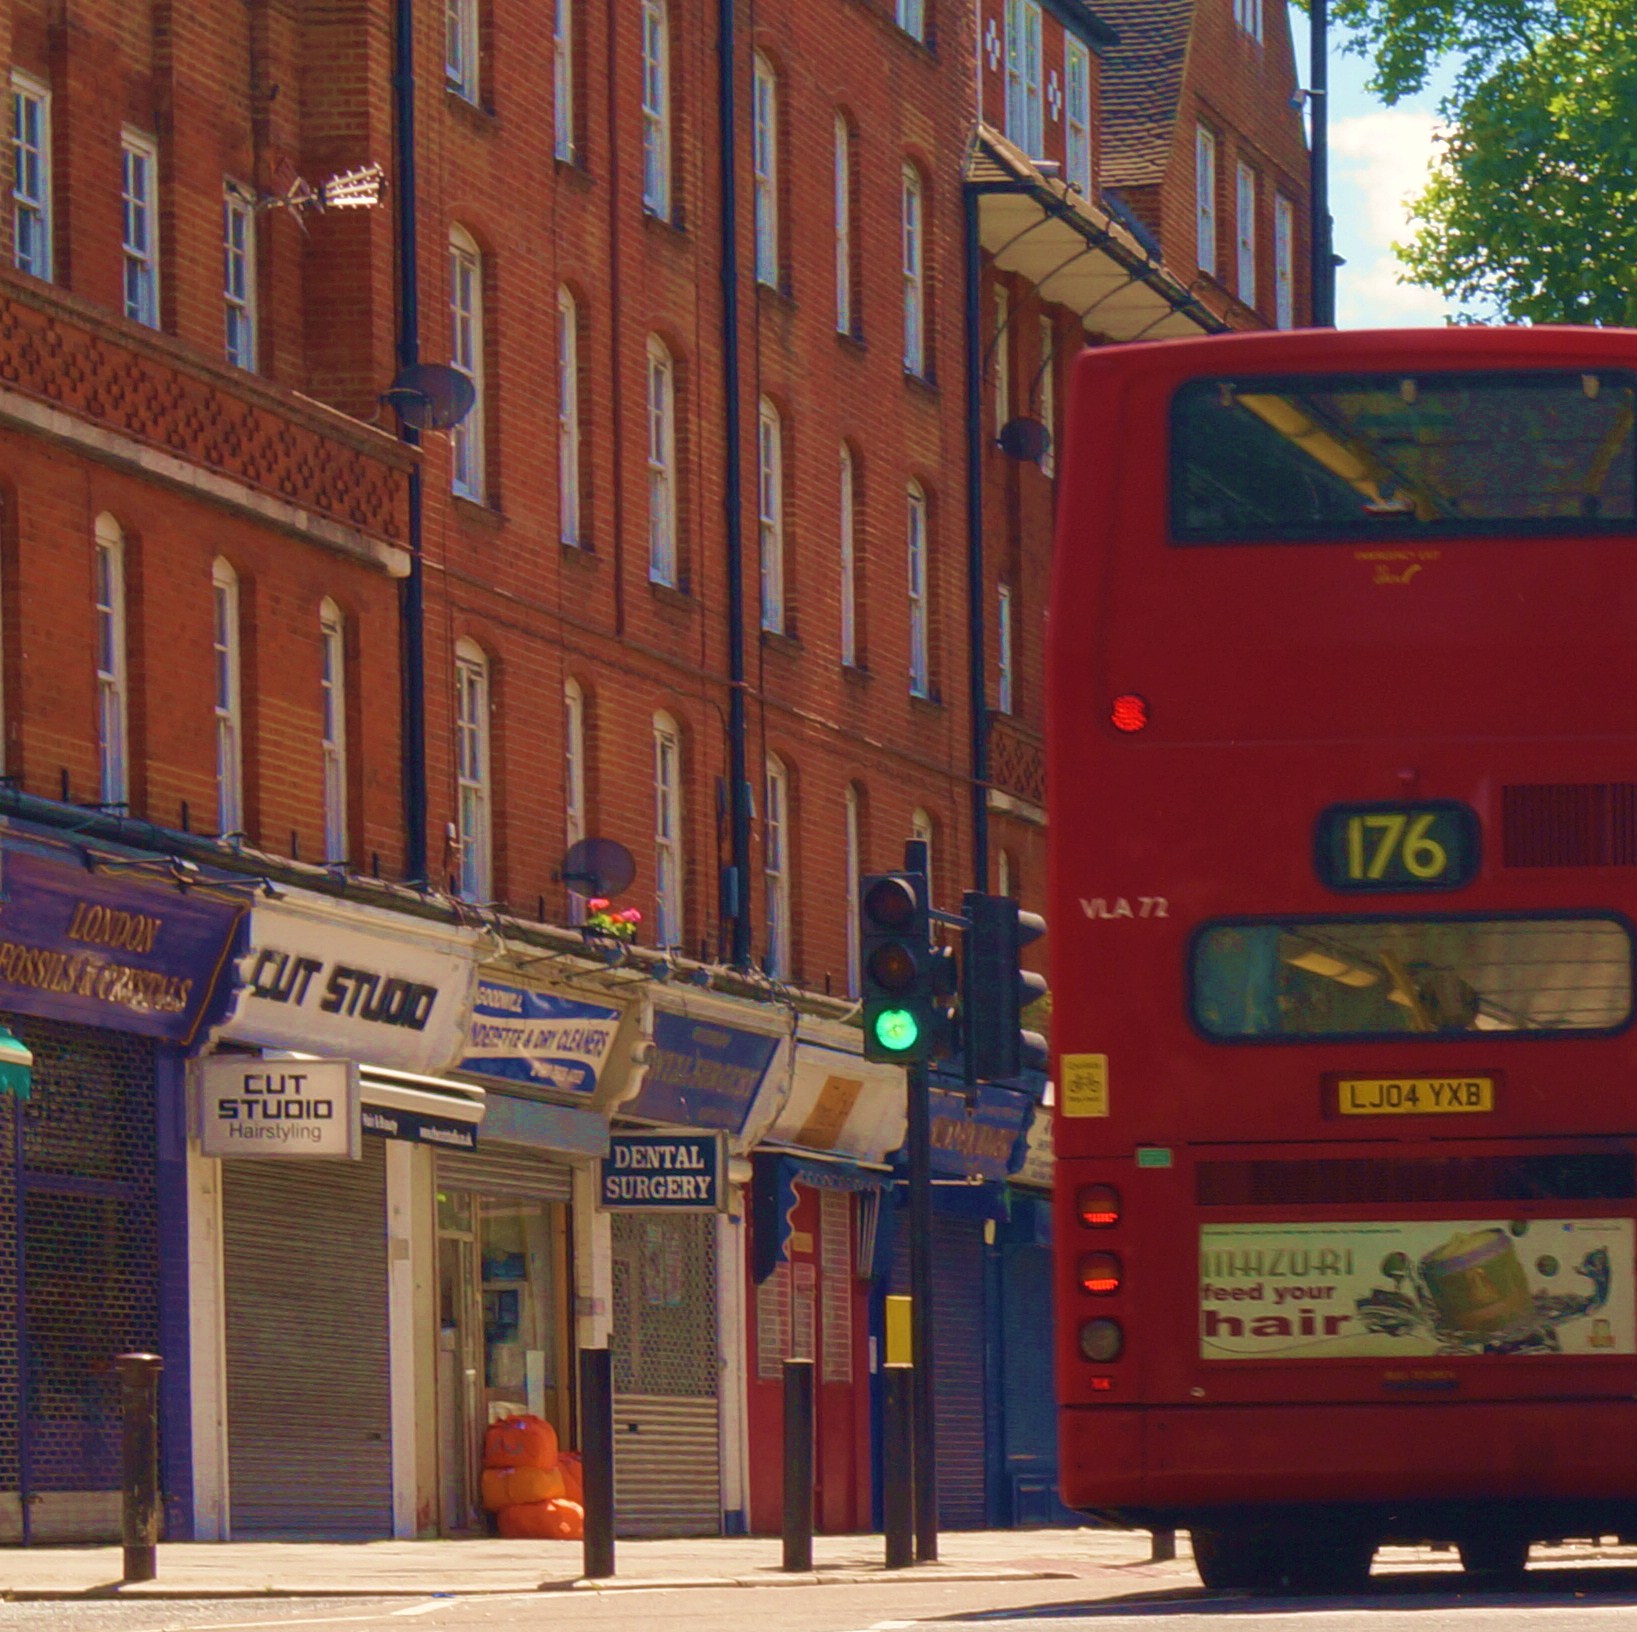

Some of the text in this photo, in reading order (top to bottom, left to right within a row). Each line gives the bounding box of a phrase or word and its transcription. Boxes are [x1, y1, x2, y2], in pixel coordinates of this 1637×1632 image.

[1348, 814, 1447, 880] 176
[1079, 896, 1170, 920] VLA 72
[69, 902, 162, 953] LONDON
[0, 943, 82, 994] FOSSILS
[251, 948, 439, 1032] CUT STUDIO
[472, 1021, 525, 1048] NDERETTE
[533, 1030, 557, 1049] DRY
[557, 1029, 610, 1057] CLEANERS
[244, 1074, 308, 1094] CUT
[1350, 1083, 1480, 1108] LJ04 YXB
[218, 1099, 333, 1119] STUDIO
[230, 1122, 322, 1143] Hairstyling
[614, 1145, 705, 1169] DENTAL
[606, 1175, 712, 1199] SURGERY
[1203, 1282, 1337, 1305] feed your
[1202, 1308, 1353, 1337] hair
